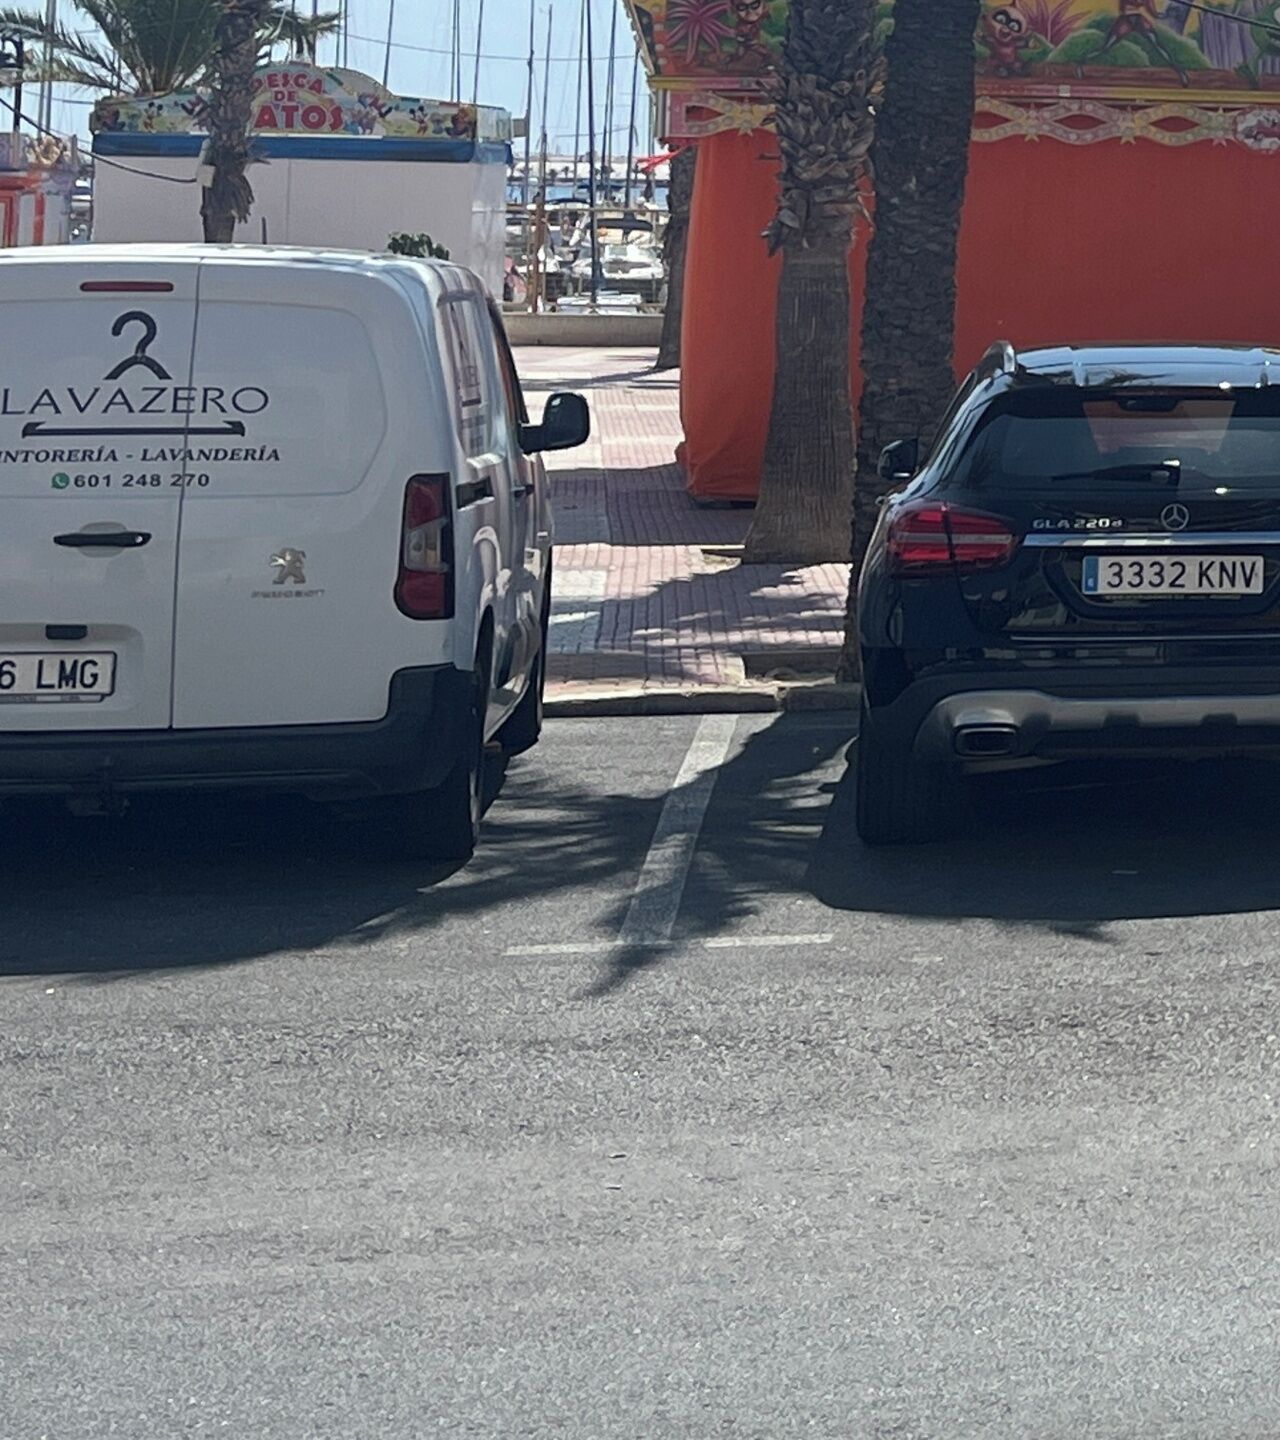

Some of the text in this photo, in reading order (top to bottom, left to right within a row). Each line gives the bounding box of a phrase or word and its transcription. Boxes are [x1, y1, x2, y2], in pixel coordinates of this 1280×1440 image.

[273, 90, 297, 102] DE
[253, 105, 344, 131] ATOS
[1, 386, 269, 415] LAVAZERO
[141, 445, 280, 462] LAVANDERÍA
[74, 473, 209, 488] 601 248 270
[1106, 560, 1256, 589] 3332 KNV
[36, 659, 98, 689] LMG
